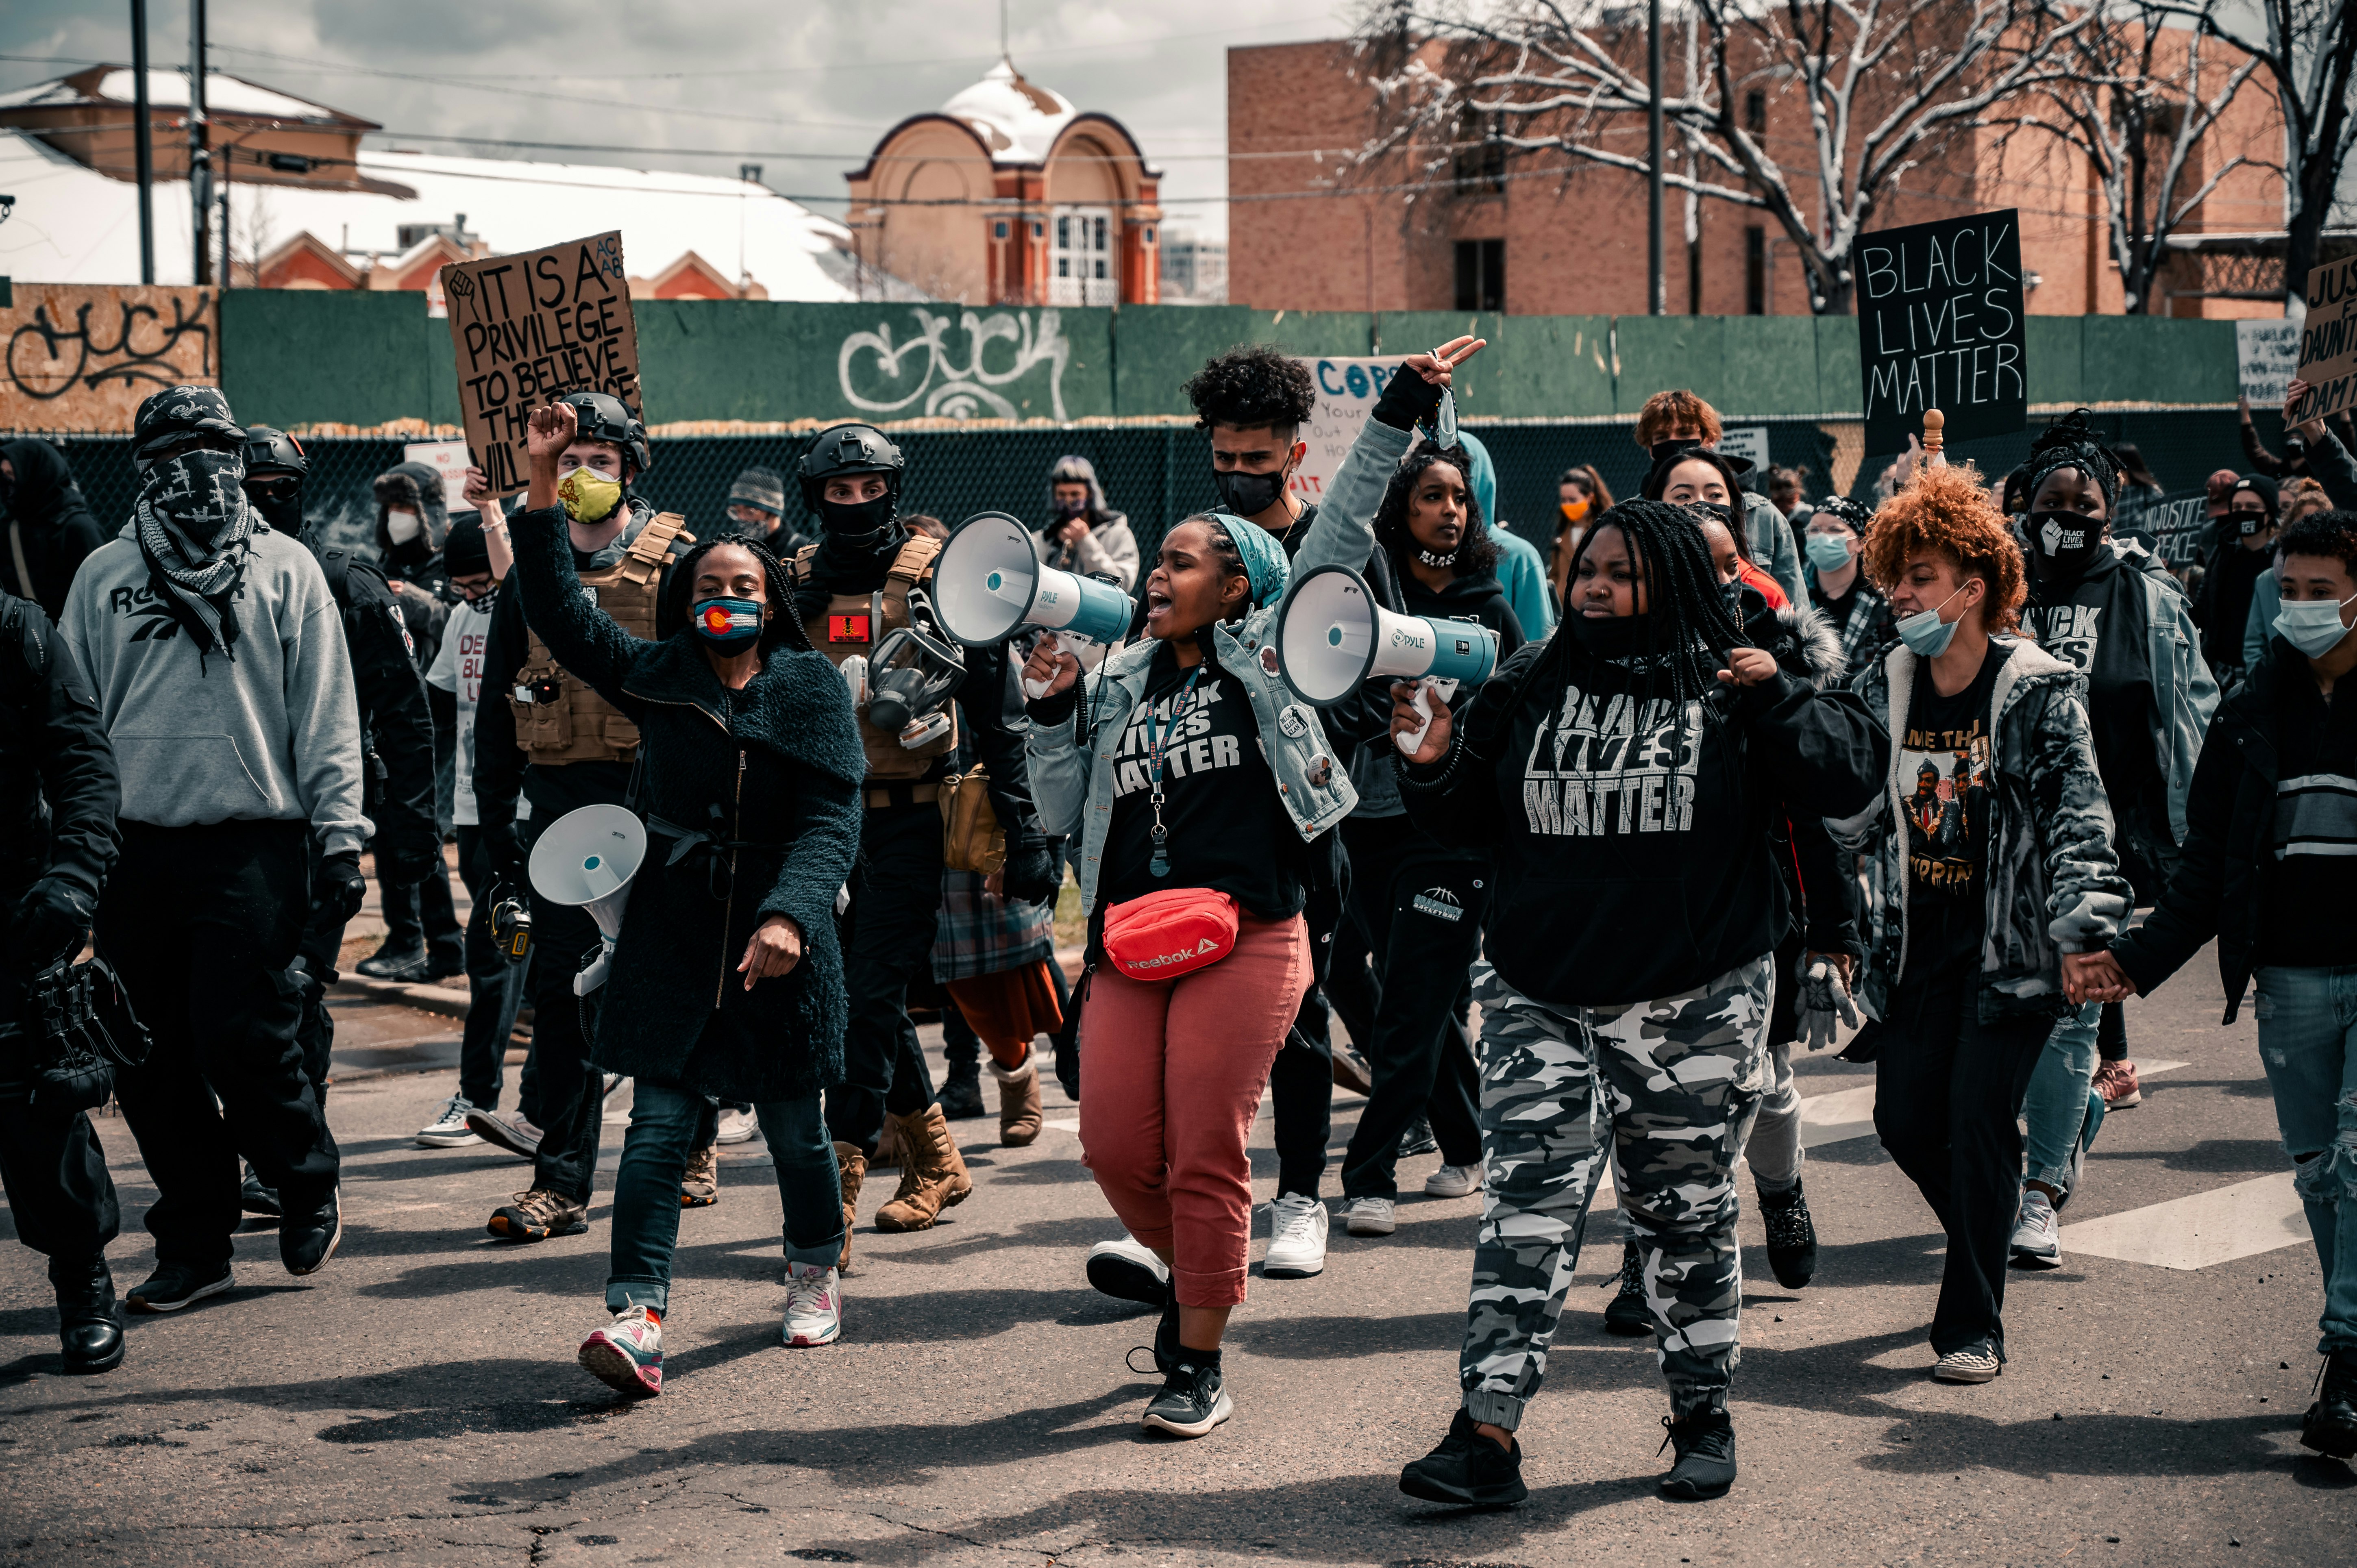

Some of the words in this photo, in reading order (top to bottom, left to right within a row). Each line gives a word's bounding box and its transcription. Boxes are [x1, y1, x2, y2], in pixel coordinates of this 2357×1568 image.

[596, 237, 617, 260] AC
[601, 258, 623, 279] AB
[1864, 224, 2016, 298] BLACK
[477, 265, 512, 322] IT
[523, 255, 565, 311] IS
[573, 245, 609, 303] A
[1878, 289, 2013, 354] LIVES
[464, 296, 623, 372] PRIVILEGE
[466, 371, 509, 411] TO
[512, 338, 627, 397] BELIEVE
[1867, 344, 2022, 420] MATTER
[1321, 402, 1362, 419] Your
[1312, 425, 1342, 438] Out
[435, 452, 450, 464] NO
[1130, 680, 1222, 726] ACK
[1175, 700, 1185, 715] BYERS
[1284, 718, 1297, 731] KLUX
[1288, 724, 1300, 736] KLAN
[1602, 712, 1612, 732] Trayvon
[1114, 710, 1210, 759] IVES
[1113, 735, 1240, 798] ATTER
[1524, 776, 1695, 835] MATTER
[1413, 903, 1460, 921] BASKETBALL
[1414, 894, 1464, 918] GRANDVIEW
[1125, 949, 1196, 969] Reebok
